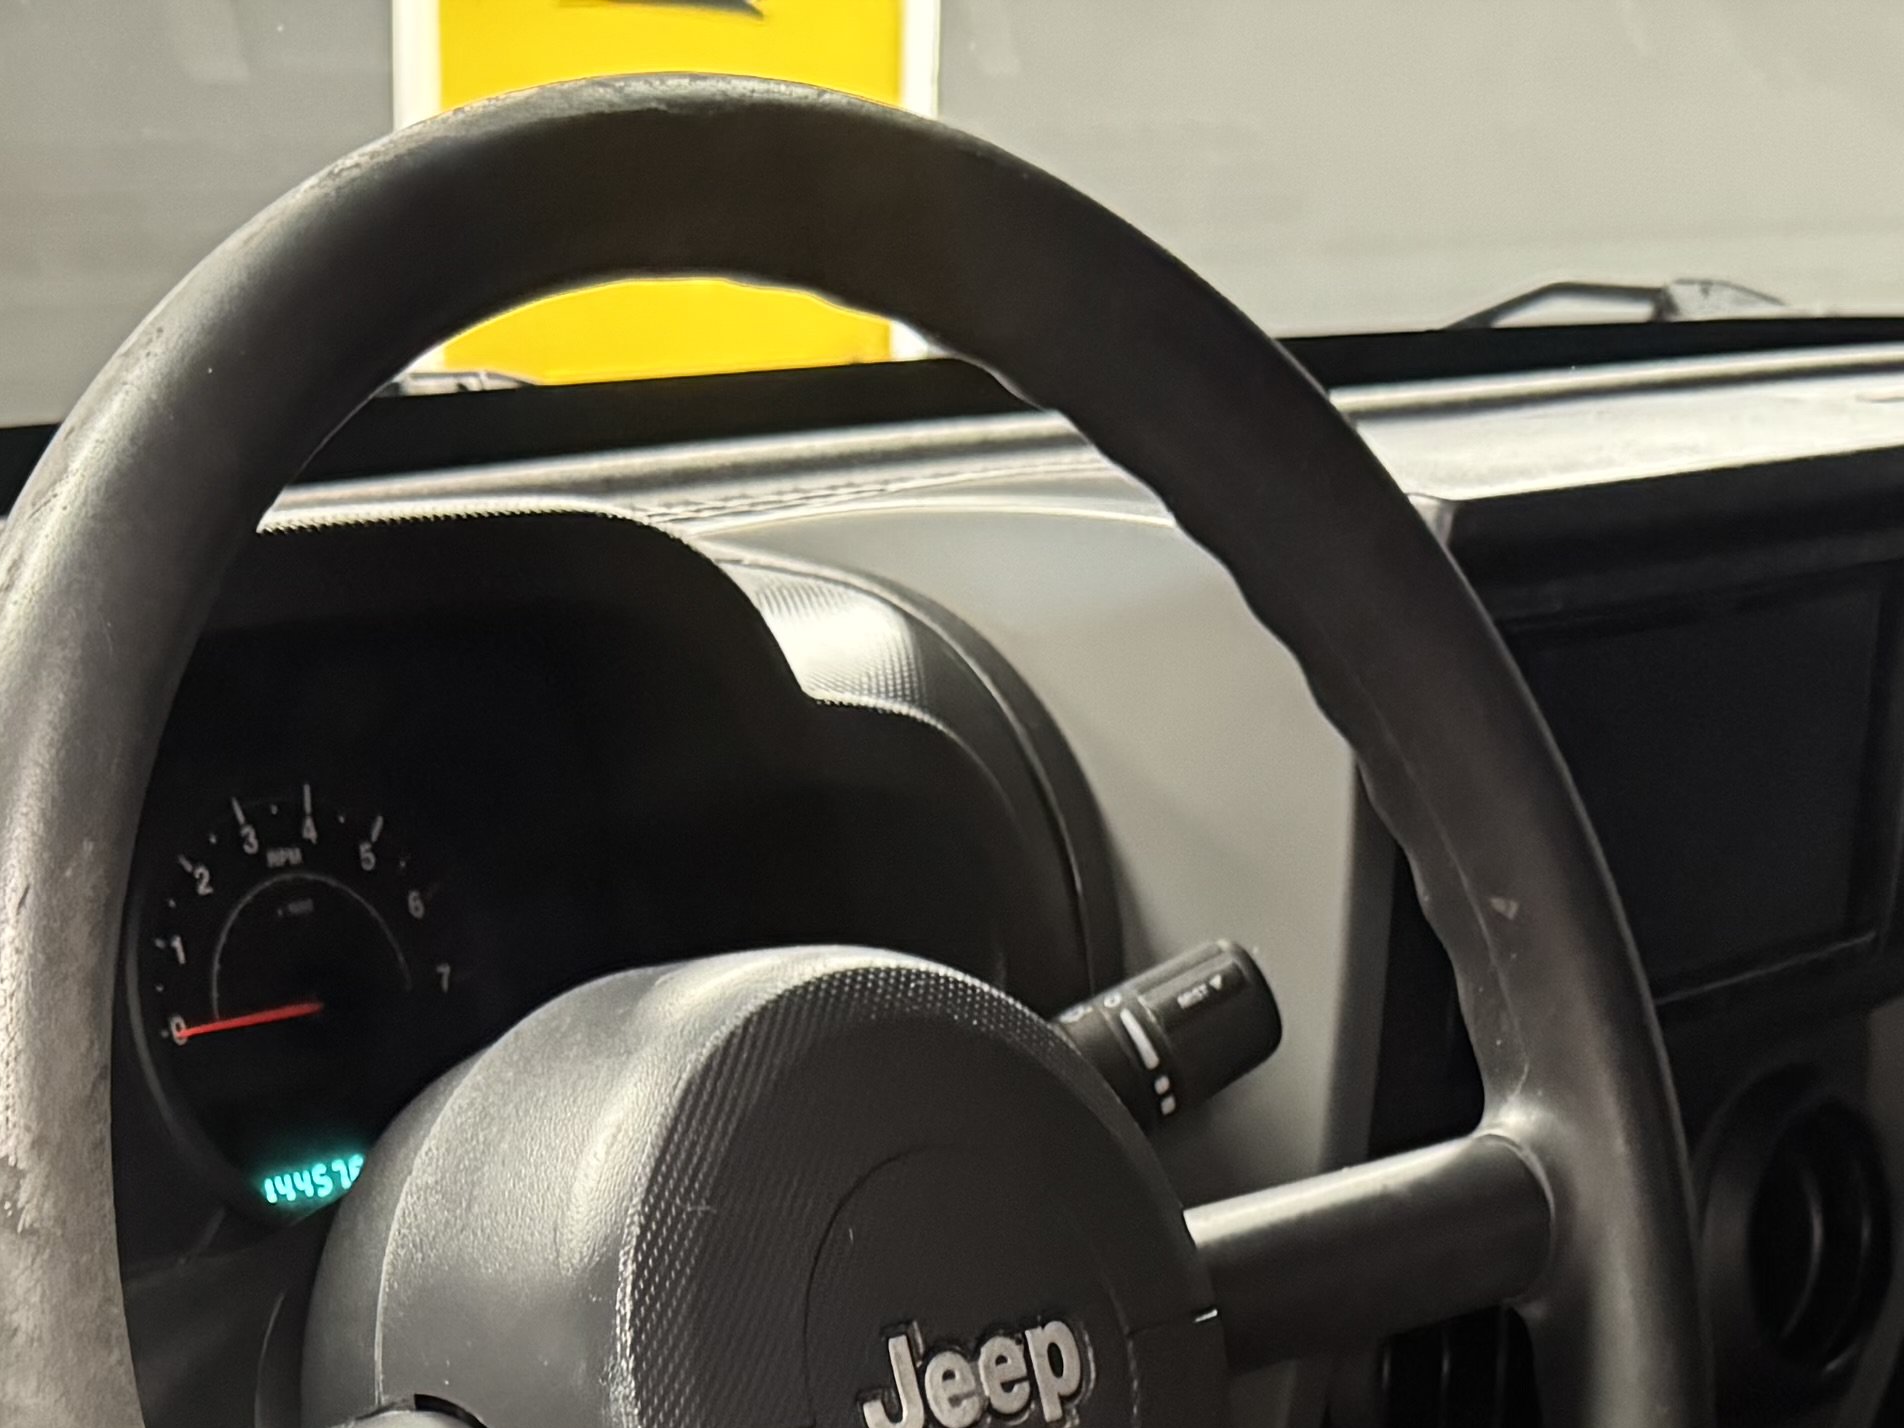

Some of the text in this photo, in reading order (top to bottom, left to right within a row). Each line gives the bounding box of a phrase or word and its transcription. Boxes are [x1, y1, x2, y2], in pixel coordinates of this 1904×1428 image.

[240, 825, 258, 855] 3
[302, 815, 317, 845] 4
[359, 842, 376, 871] 5
[194, 867, 213, 895] 2
[407, 890, 425, 919] 6
[171, 936, 187, 966] 1
[436, 963, 452, 993] 7
